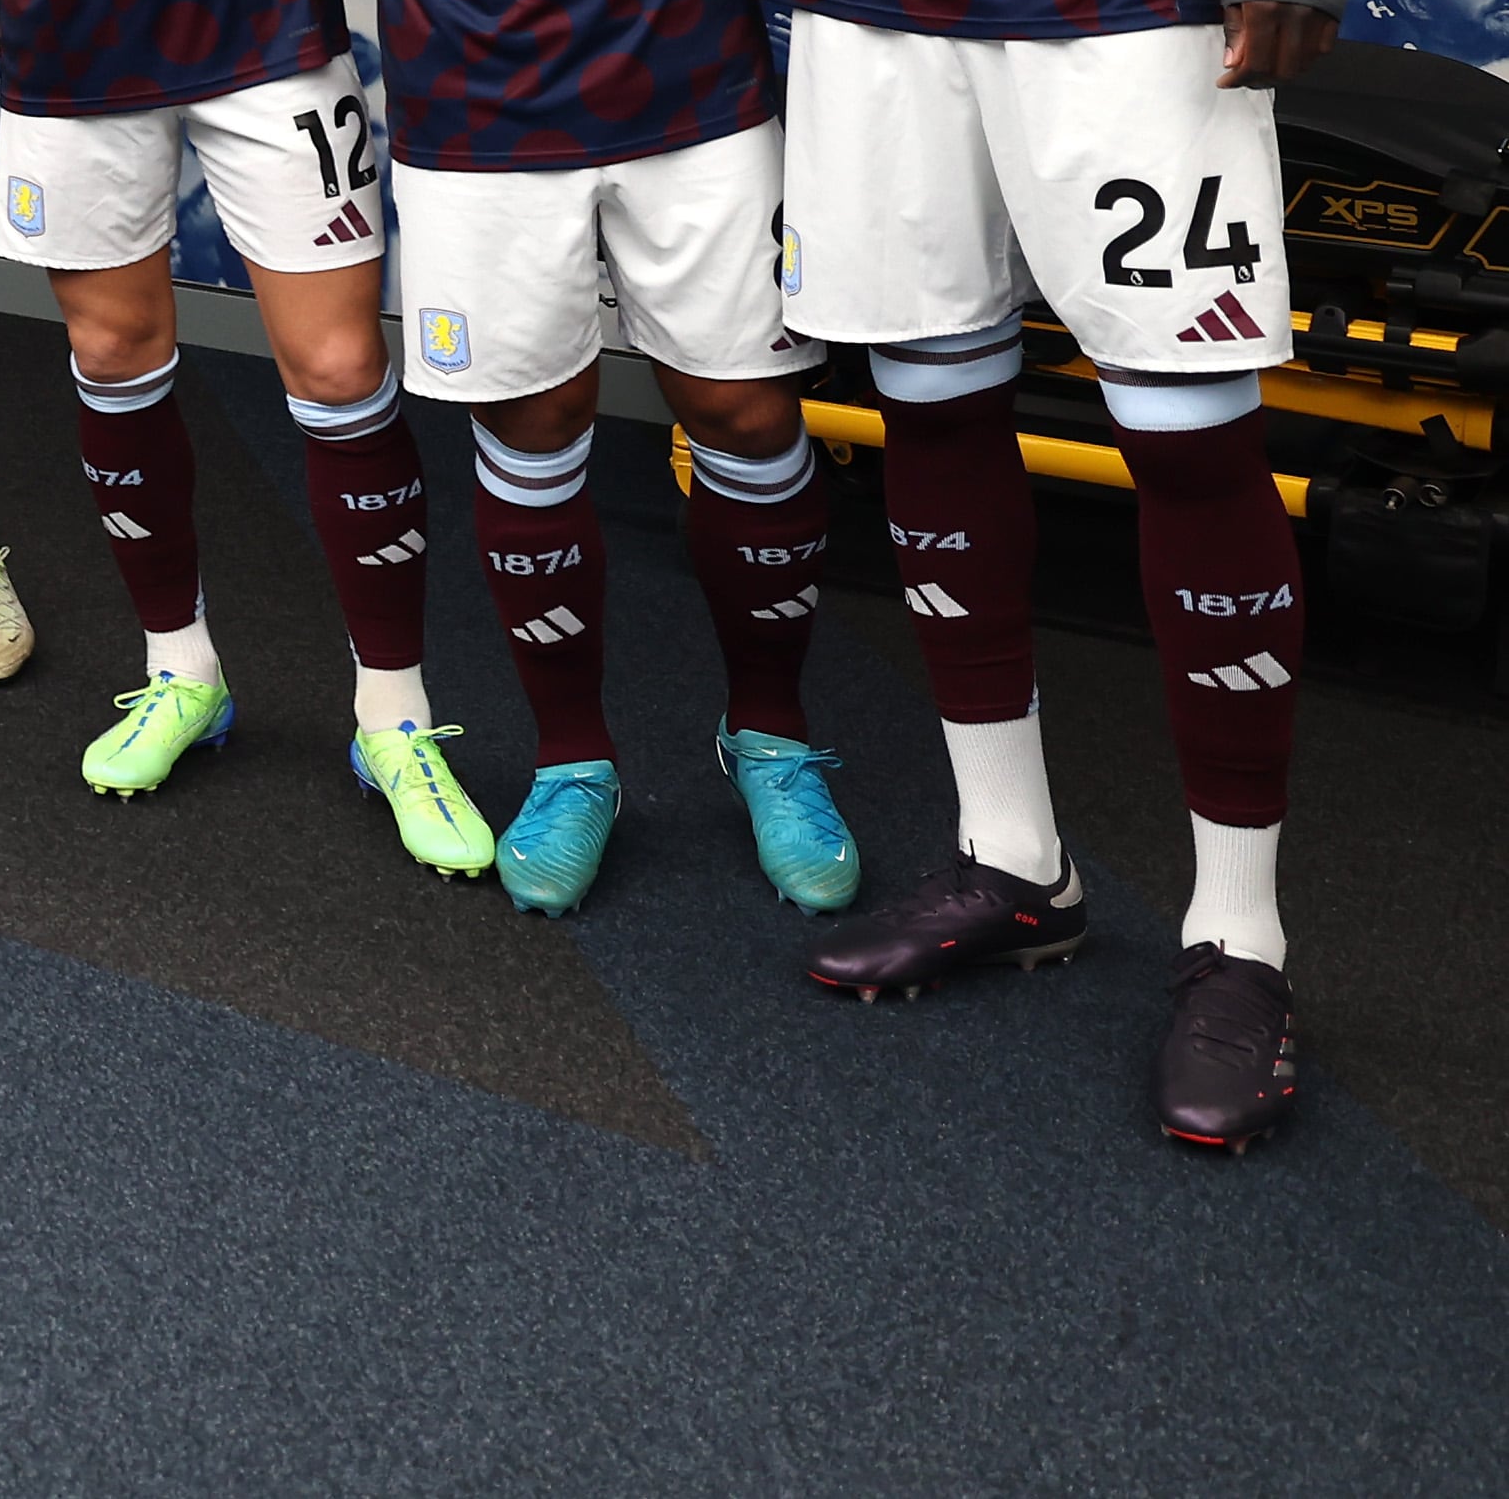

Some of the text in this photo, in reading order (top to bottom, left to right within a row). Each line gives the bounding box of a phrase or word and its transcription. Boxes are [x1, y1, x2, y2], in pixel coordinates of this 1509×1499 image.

[293, 95, 377, 199] 12
[1320, 195, 1419, 230] XPS
[1094, 175, 1261, 289] 24
[82, 458, 144, 487] 874
[339, 477, 423, 512] 1874
[888, 516, 972, 552] 874
[487, 543, 584, 577] 1874
[1174, 583, 1295, 617] 1874
